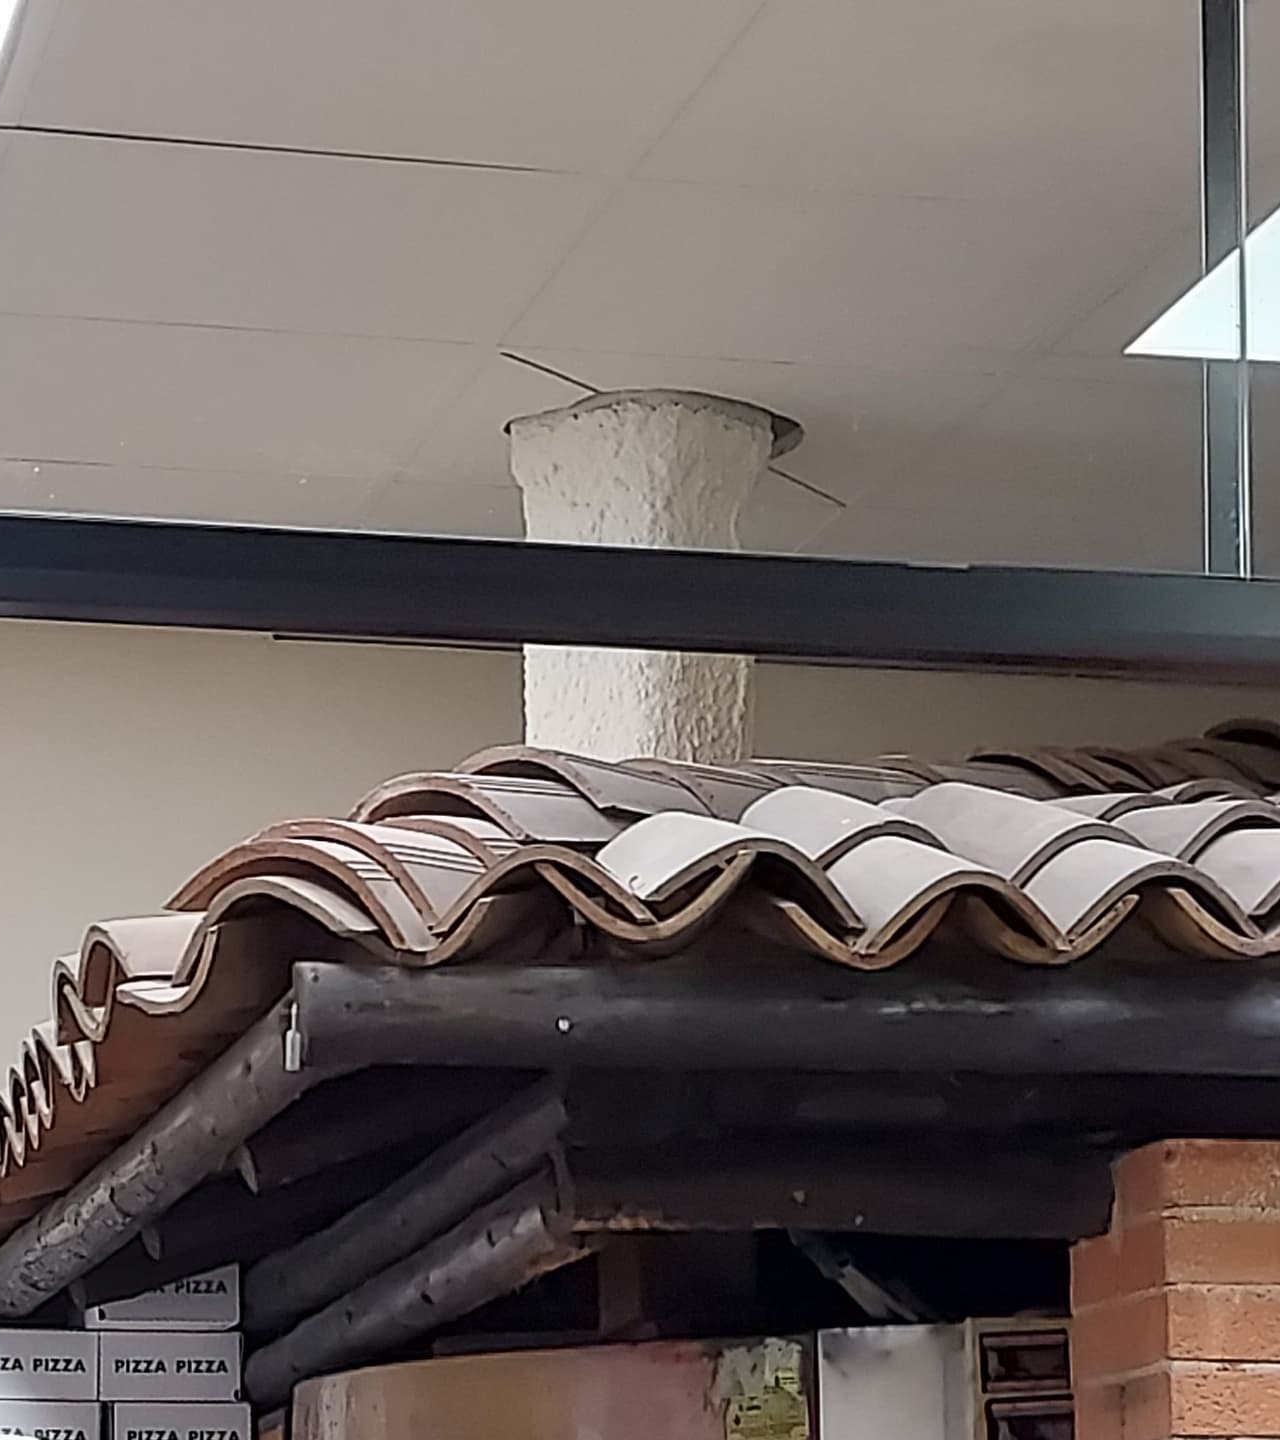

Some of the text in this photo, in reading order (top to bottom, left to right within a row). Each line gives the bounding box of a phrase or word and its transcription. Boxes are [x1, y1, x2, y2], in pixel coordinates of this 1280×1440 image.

[174, 1280, 227, 1294] PIZZA
[33, 1358, 86, 1374] PIZZA
[115, 1360, 228, 1374] PIZZA PIZZA
